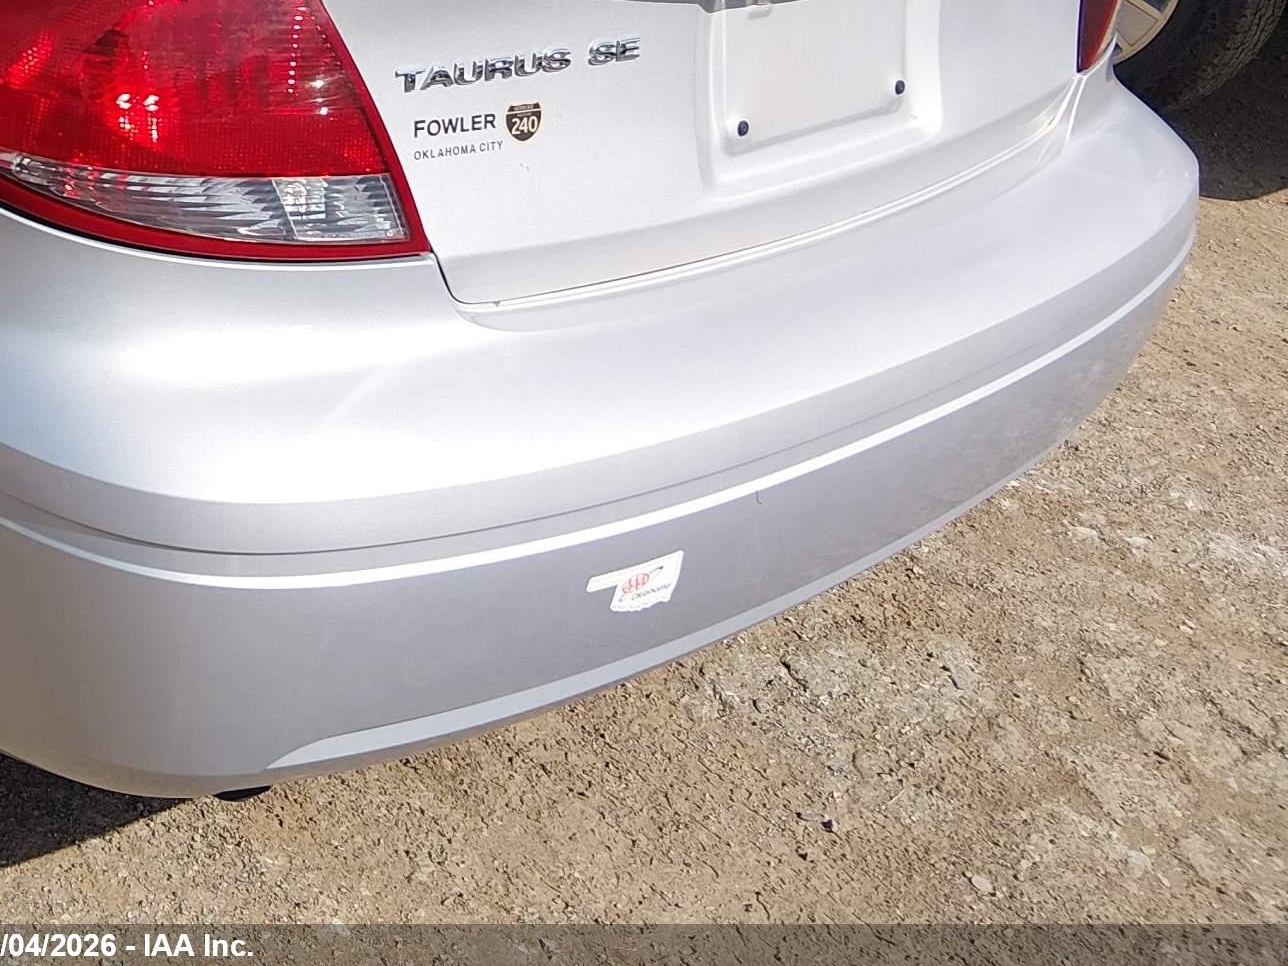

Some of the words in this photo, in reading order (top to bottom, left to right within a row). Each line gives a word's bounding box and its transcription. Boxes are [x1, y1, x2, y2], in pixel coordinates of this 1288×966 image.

[395, 47, 571, 93] TAURUS
[587, 37, 641, 65] SE
[413, 113, 496, 138] FOWLER
[511, 116, 538, 135] 240
[413, 144, 476, 161] OKLAHOMA
[479, 140, 503, 153] CITY
